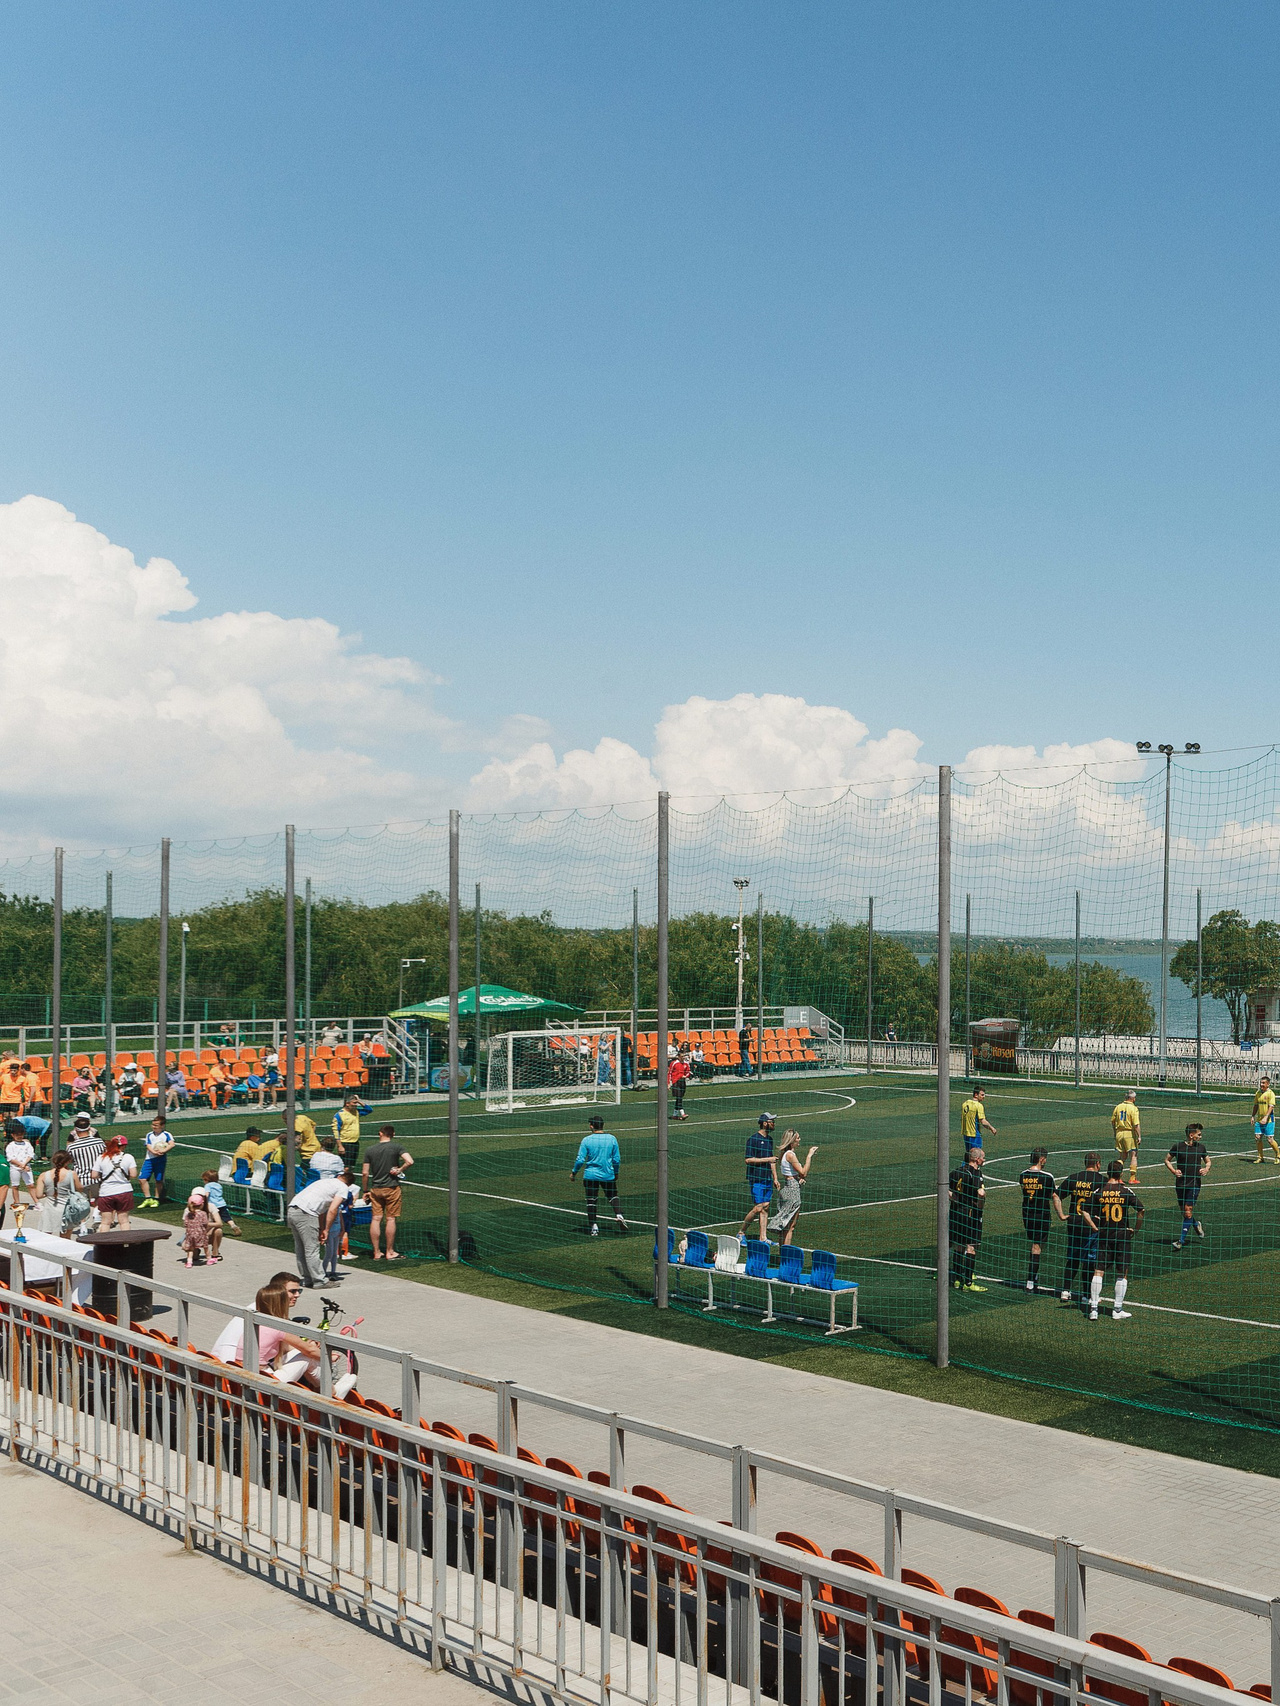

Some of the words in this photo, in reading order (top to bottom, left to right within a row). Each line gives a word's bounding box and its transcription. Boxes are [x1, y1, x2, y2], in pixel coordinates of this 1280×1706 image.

[478, 995, 544, 1006] Carlsberg
[1119, 1110, 1127, 1121] 11
[1075, 1181, 1092, 1189] МФК
[1101, 1204, 1123, 1222] 10
